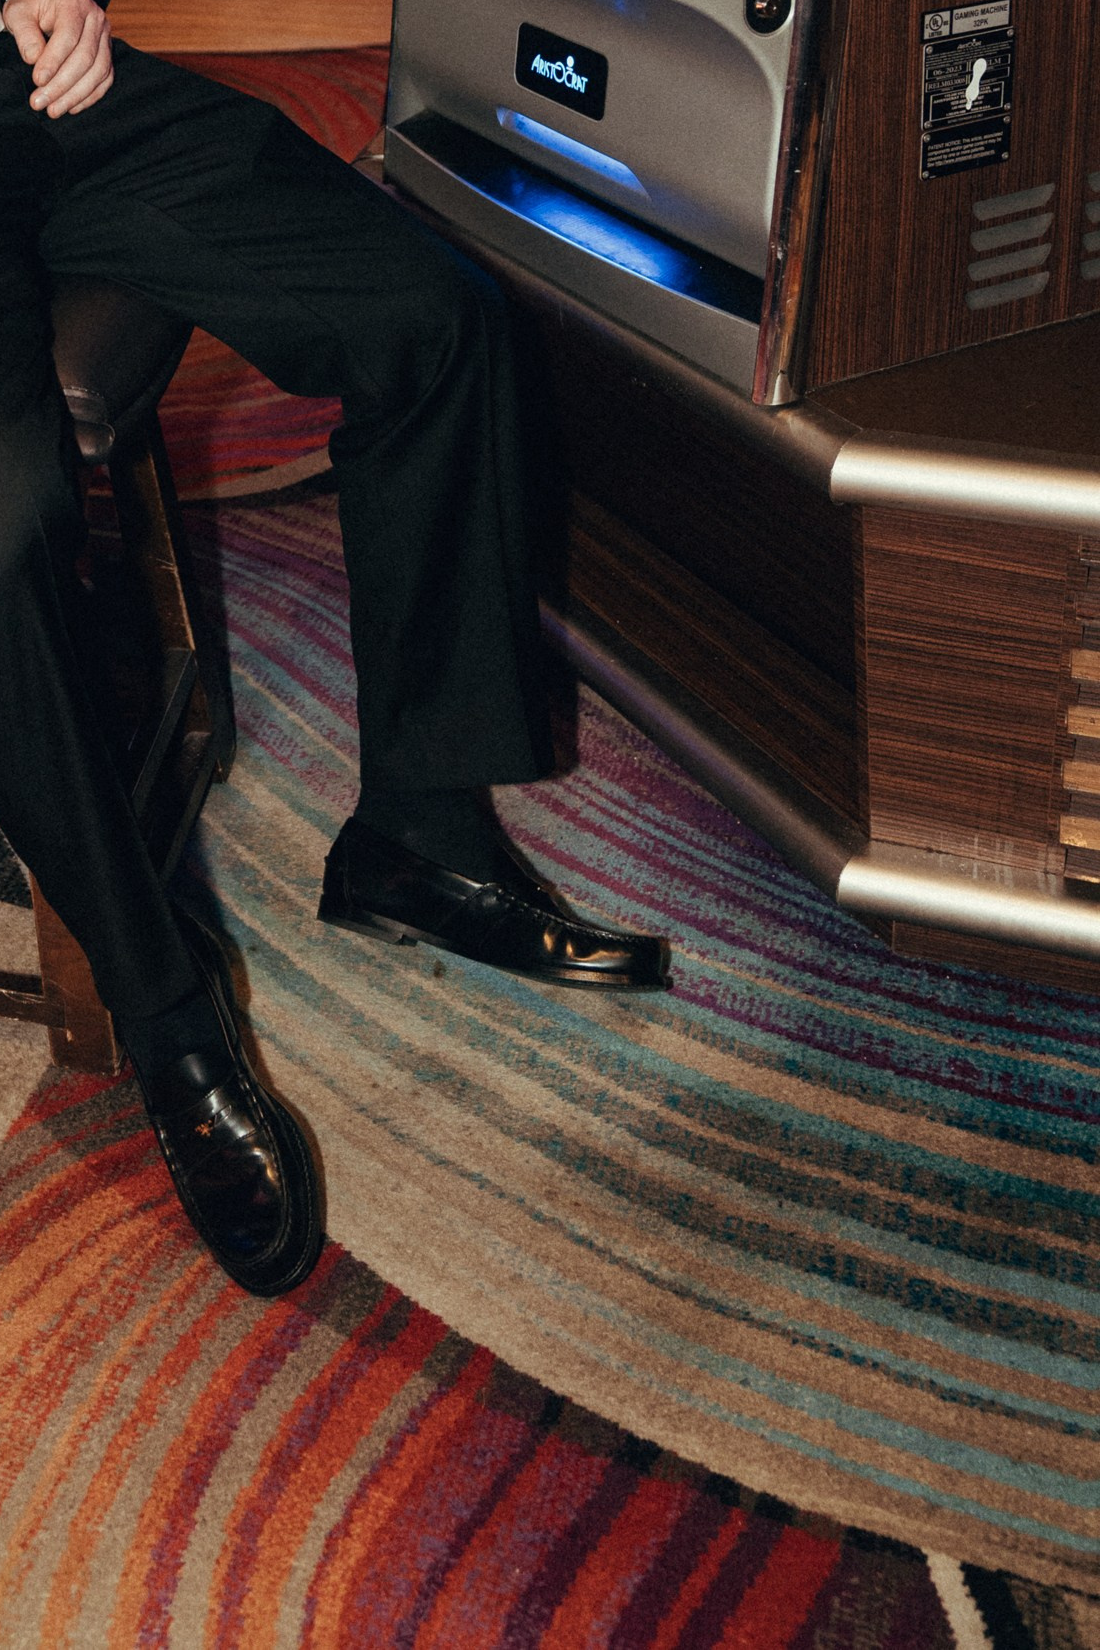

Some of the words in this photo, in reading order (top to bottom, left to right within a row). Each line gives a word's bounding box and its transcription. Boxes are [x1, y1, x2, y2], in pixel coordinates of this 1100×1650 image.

[954, 9, 979, 20] GAMING
[980, 4, 1008, 15] MACHINE
[973, 18, 988, 27] 32PK
[531, 54, 588, 93] ARISTOCRAT
[933, 64, 962, 76] 06-2023
[928, 142, 944, 150] PATENT
